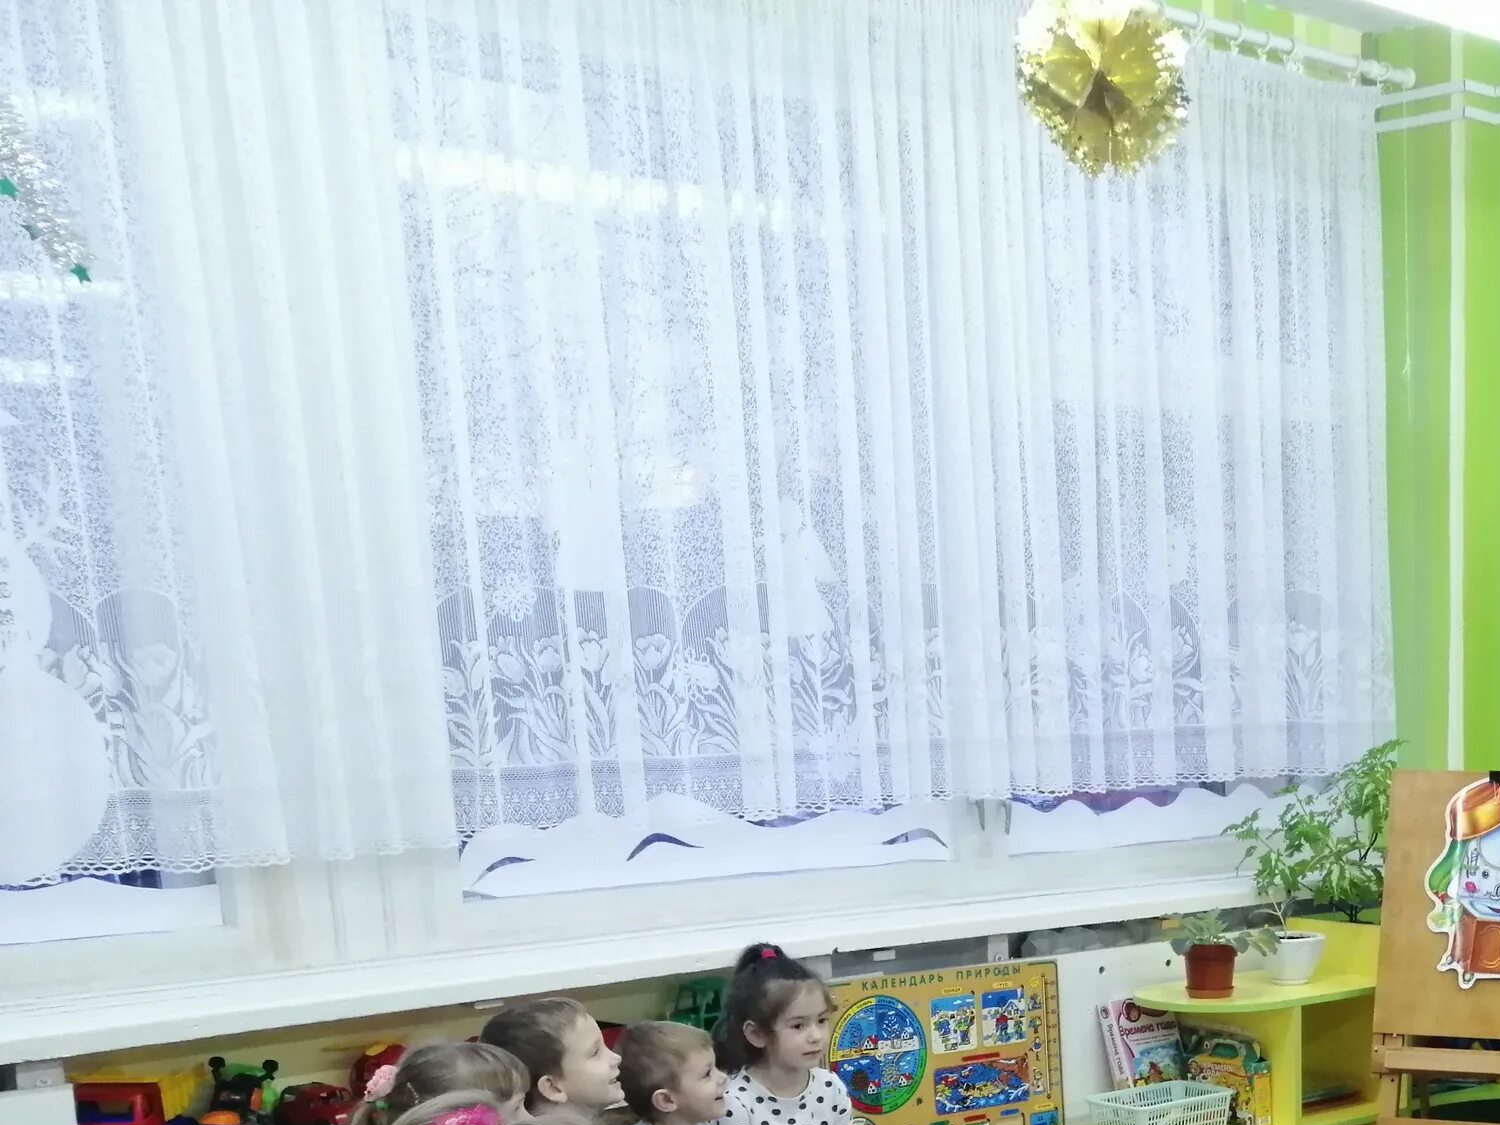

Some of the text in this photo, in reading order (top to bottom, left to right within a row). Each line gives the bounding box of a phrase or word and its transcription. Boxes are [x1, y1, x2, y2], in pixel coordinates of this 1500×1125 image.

[861, 966, 1021, 991] КАЛЕНДАРЬ ПРИРОДЫ
[1119, 1023, 1155, 1038] Времена
